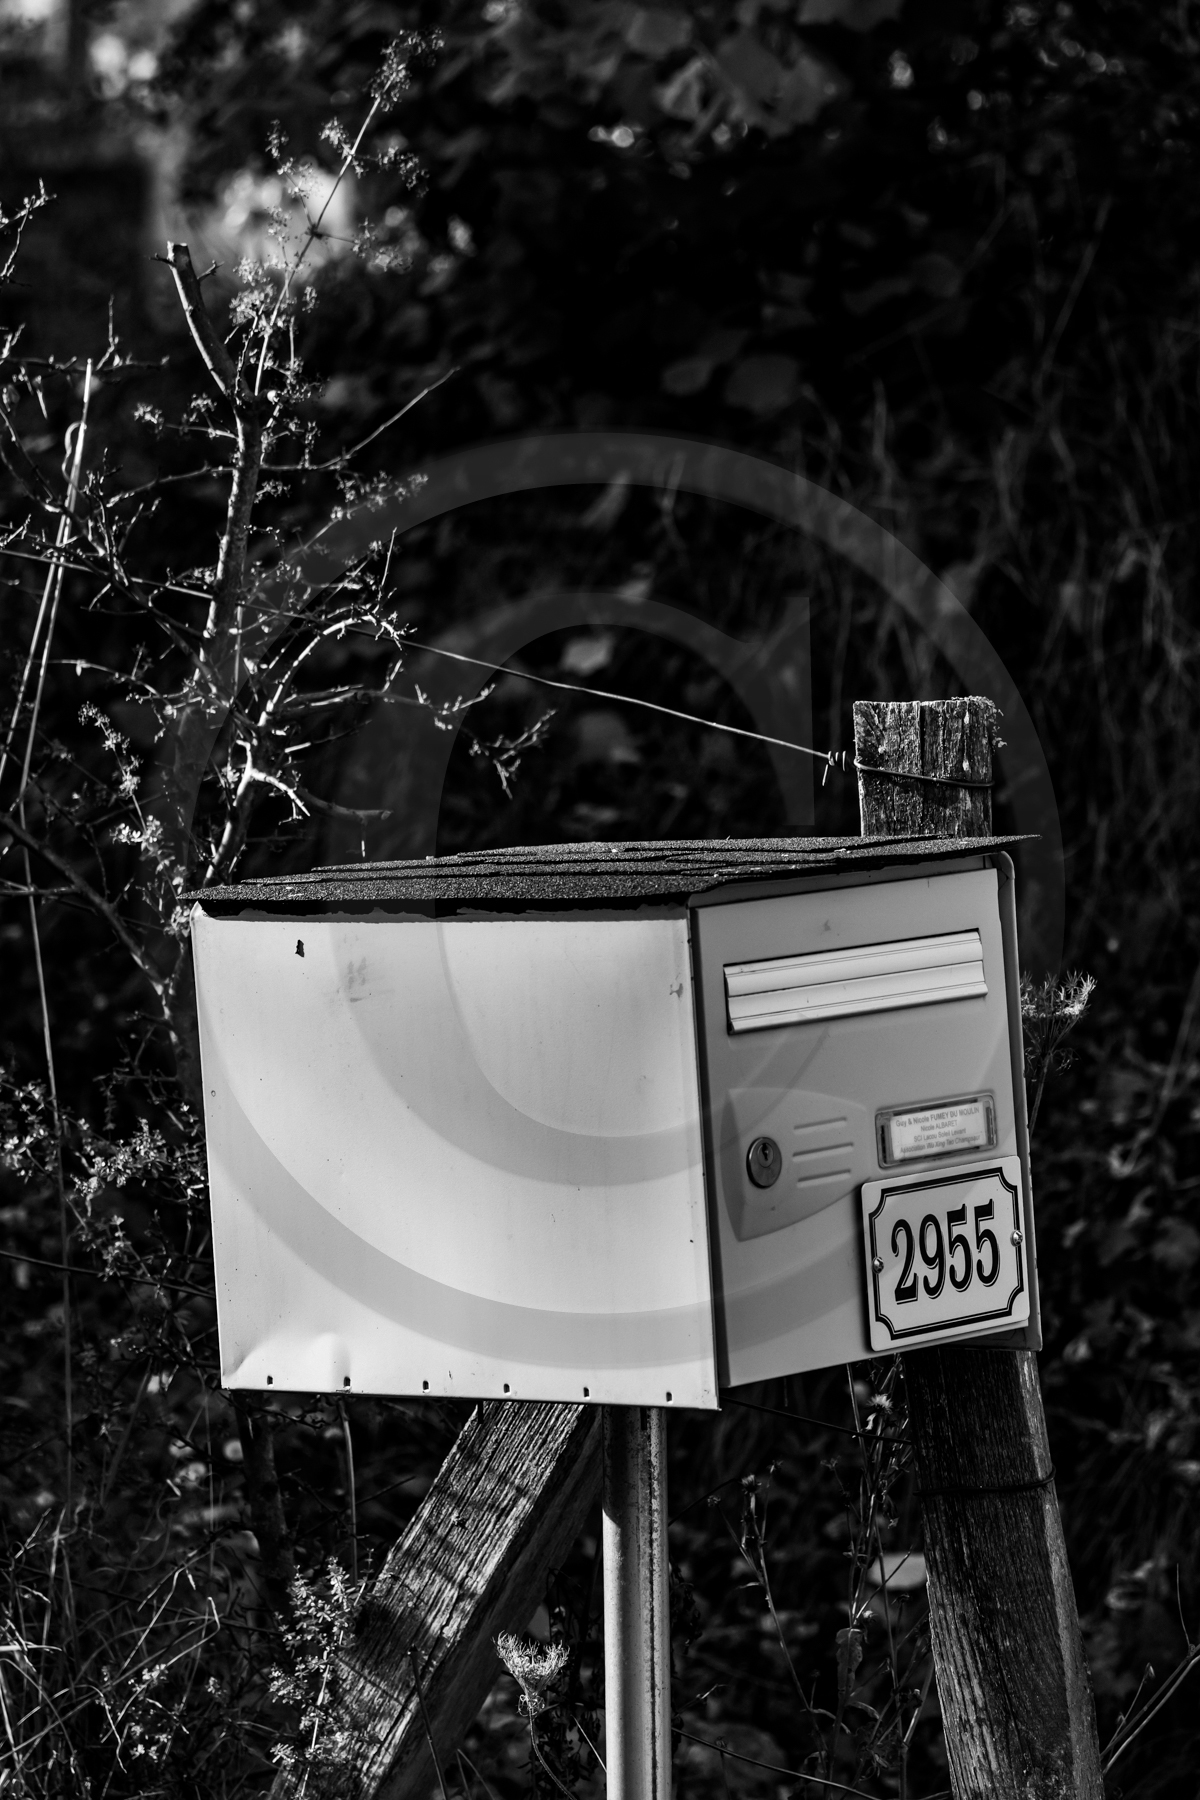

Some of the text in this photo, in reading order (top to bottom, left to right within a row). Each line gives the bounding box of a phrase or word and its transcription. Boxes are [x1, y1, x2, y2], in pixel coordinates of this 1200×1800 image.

[895, 1106, 980, 1128] Guy & Nicole FUMEY DU MOULIN
[920, 1119, 958, 1132] Nicole ALBARET
[913, 1134, 922, 1142] SCI
[891, 1198, 1001, 1305] 2955
